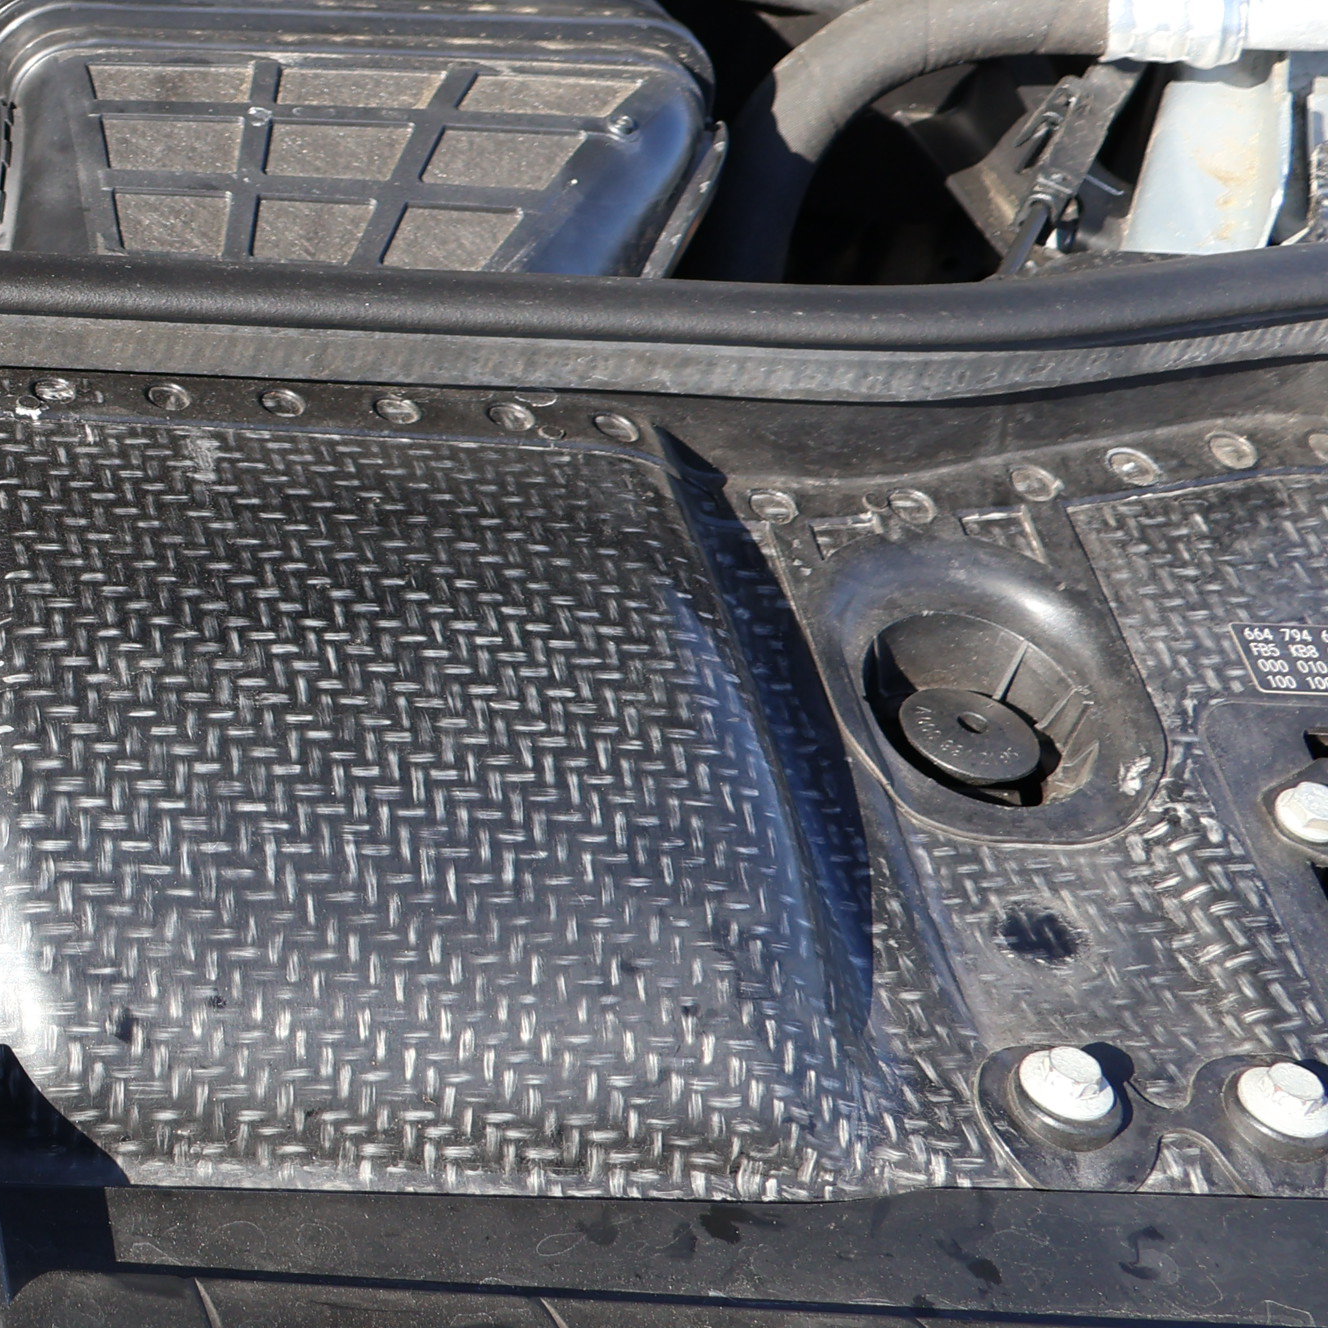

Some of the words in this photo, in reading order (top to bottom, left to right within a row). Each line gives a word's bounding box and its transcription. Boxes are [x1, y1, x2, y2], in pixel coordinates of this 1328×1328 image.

[1243, 627, 1274, 641] 664
[1279, 628, 1312, 642] 794
[1249, 642, 1280, 657] FB5
[1257, 659, 1289, 673] 000
[1296, 660, 1328, 674] 010
[1266, 675, 1297, 689] 100
